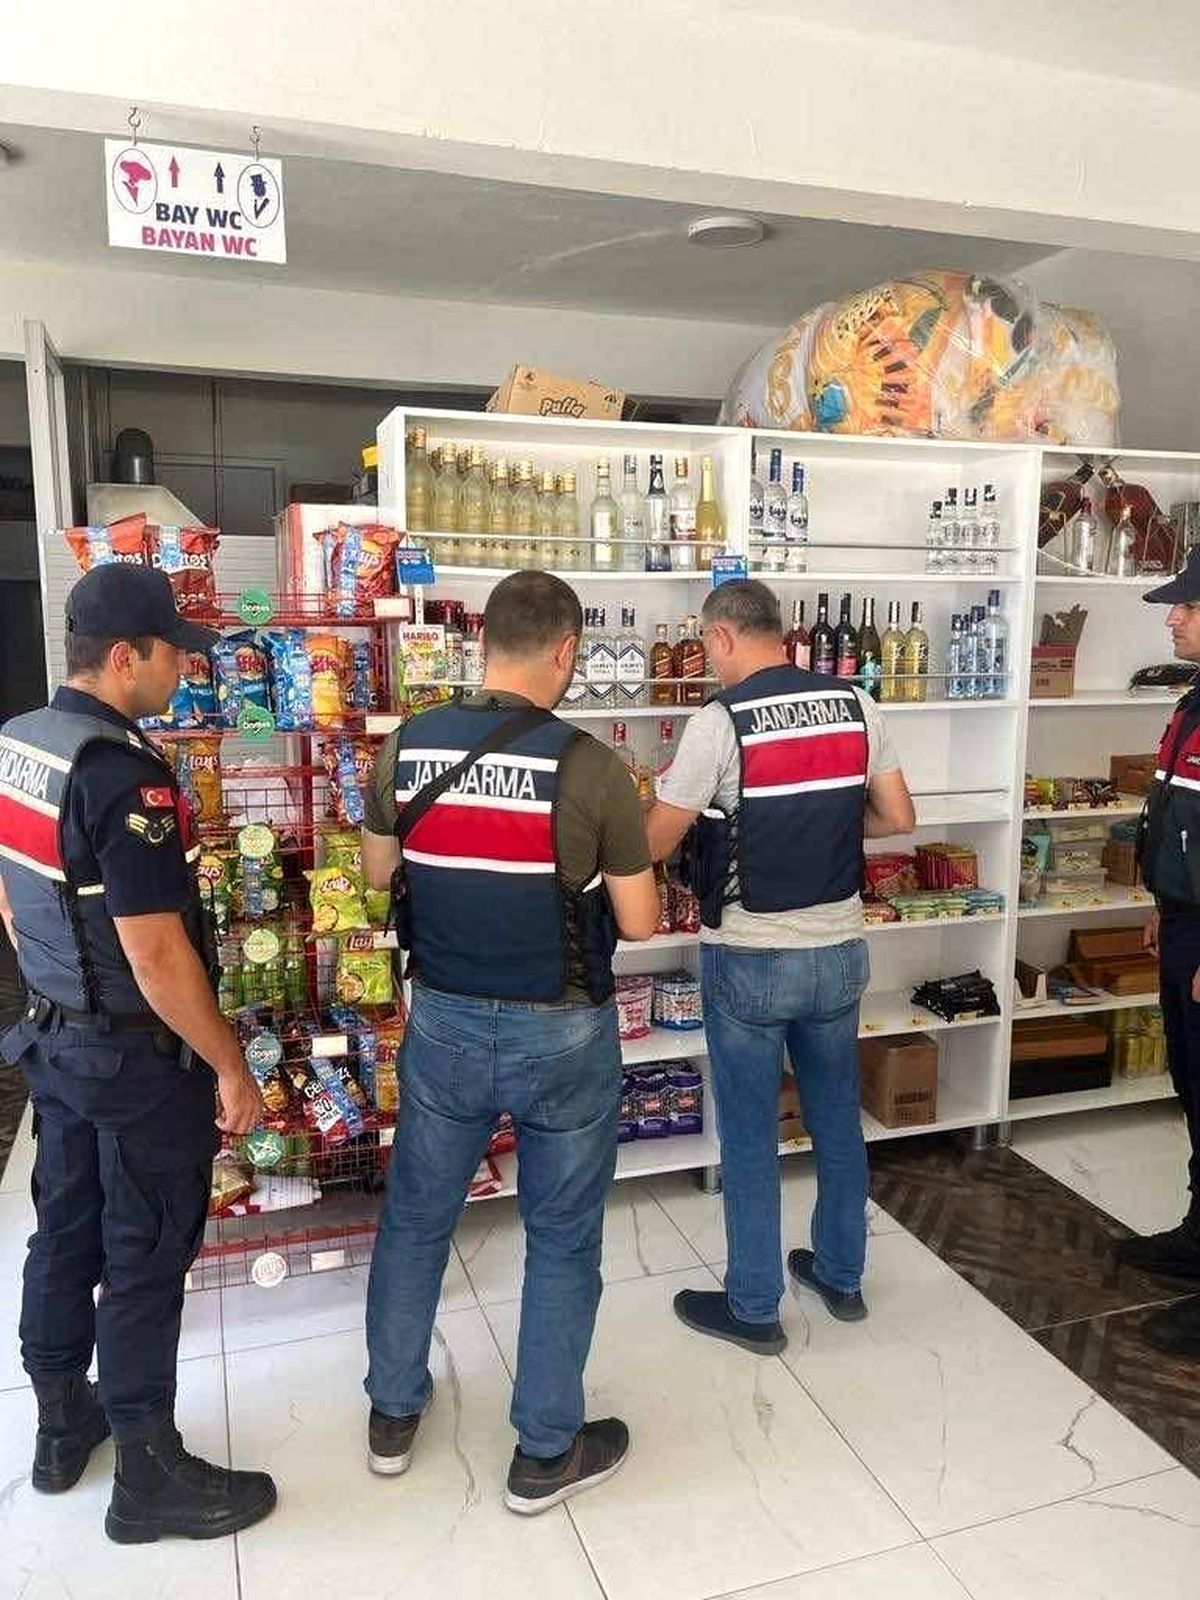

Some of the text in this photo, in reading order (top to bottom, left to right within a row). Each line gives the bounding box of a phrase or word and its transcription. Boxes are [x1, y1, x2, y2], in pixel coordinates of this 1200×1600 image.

[155, 203, 242, 230] BAY WC
[141, 226, 257, 257] BAYAN WC
[402, 632, 439, 641] HARIBO
[751, 698, 853, 734] JANDARMA
